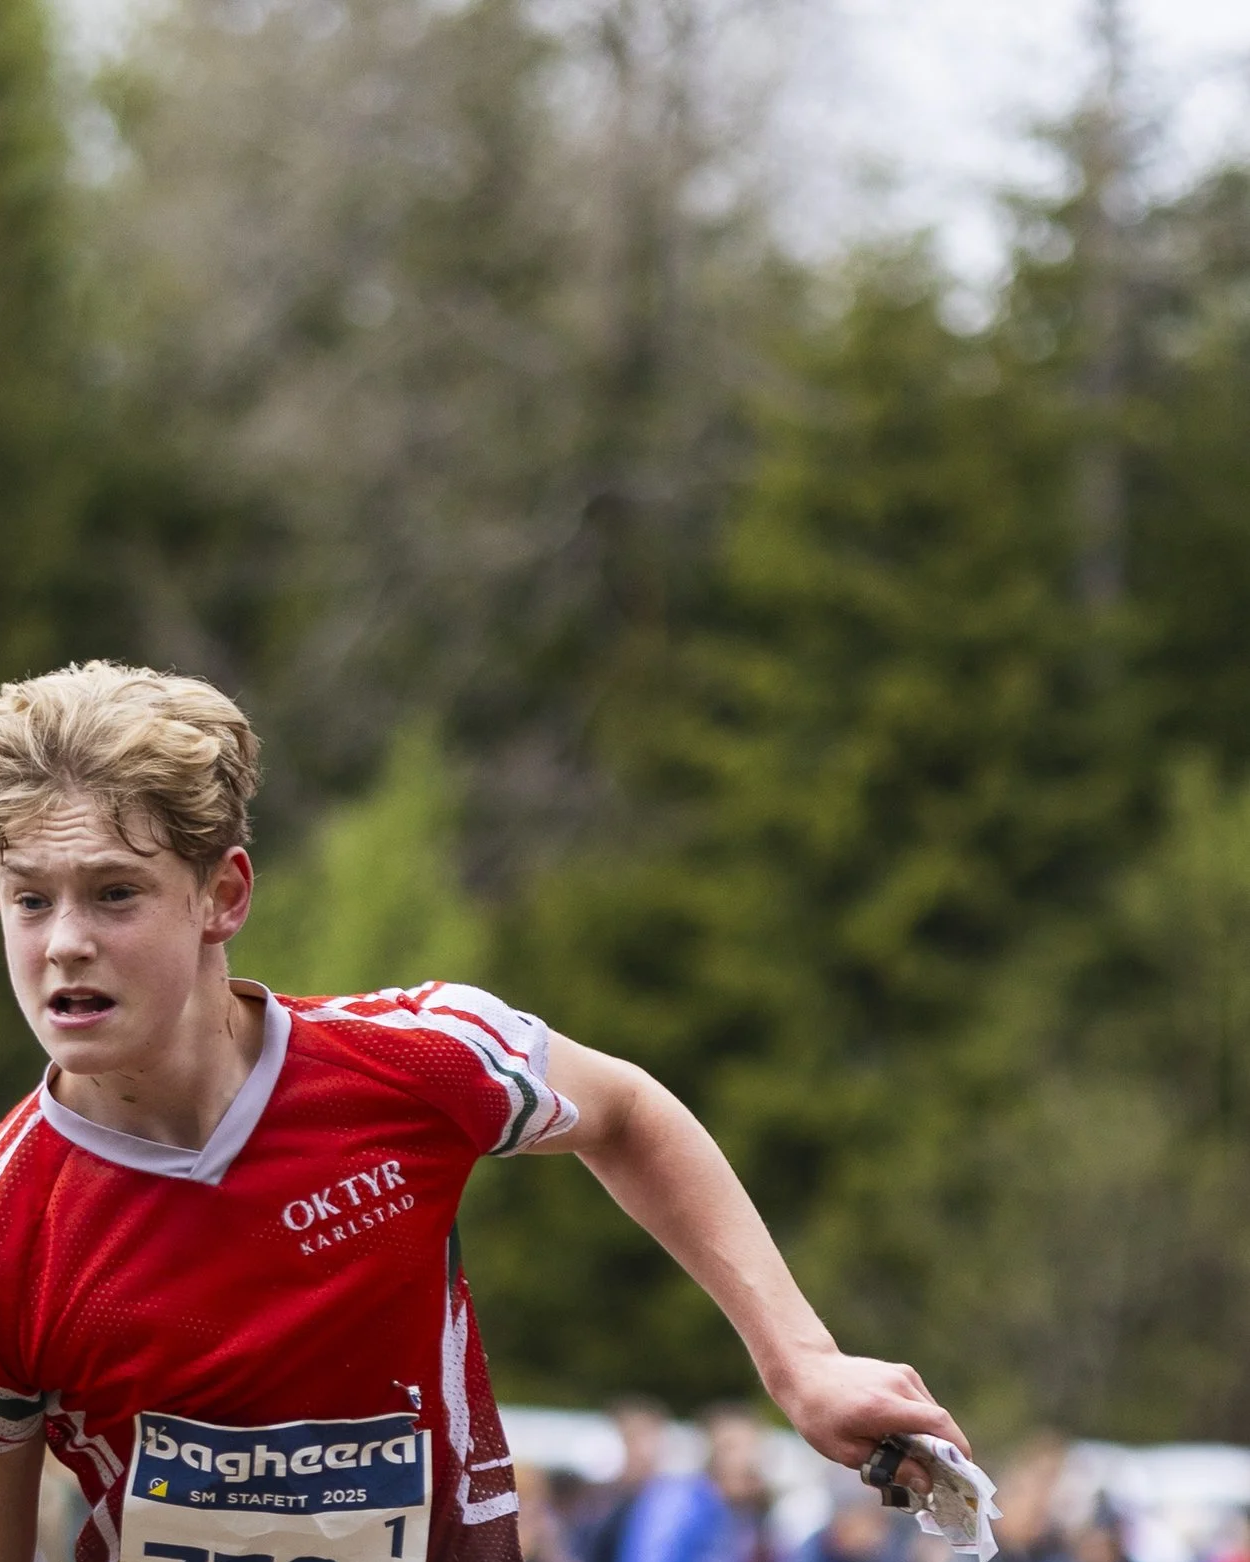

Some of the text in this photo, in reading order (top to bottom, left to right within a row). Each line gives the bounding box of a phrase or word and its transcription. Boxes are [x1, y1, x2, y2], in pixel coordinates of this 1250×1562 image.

[282, 1160, 406, 1231] OK TYR
[300, 1194, 415, 1256] KARLSTAD
[145, 1426, 416, 1483] bagheera
[190, 1489, 368, 1508] SM STAFETT 2025
[384, 1515, 406, 1559] 1
